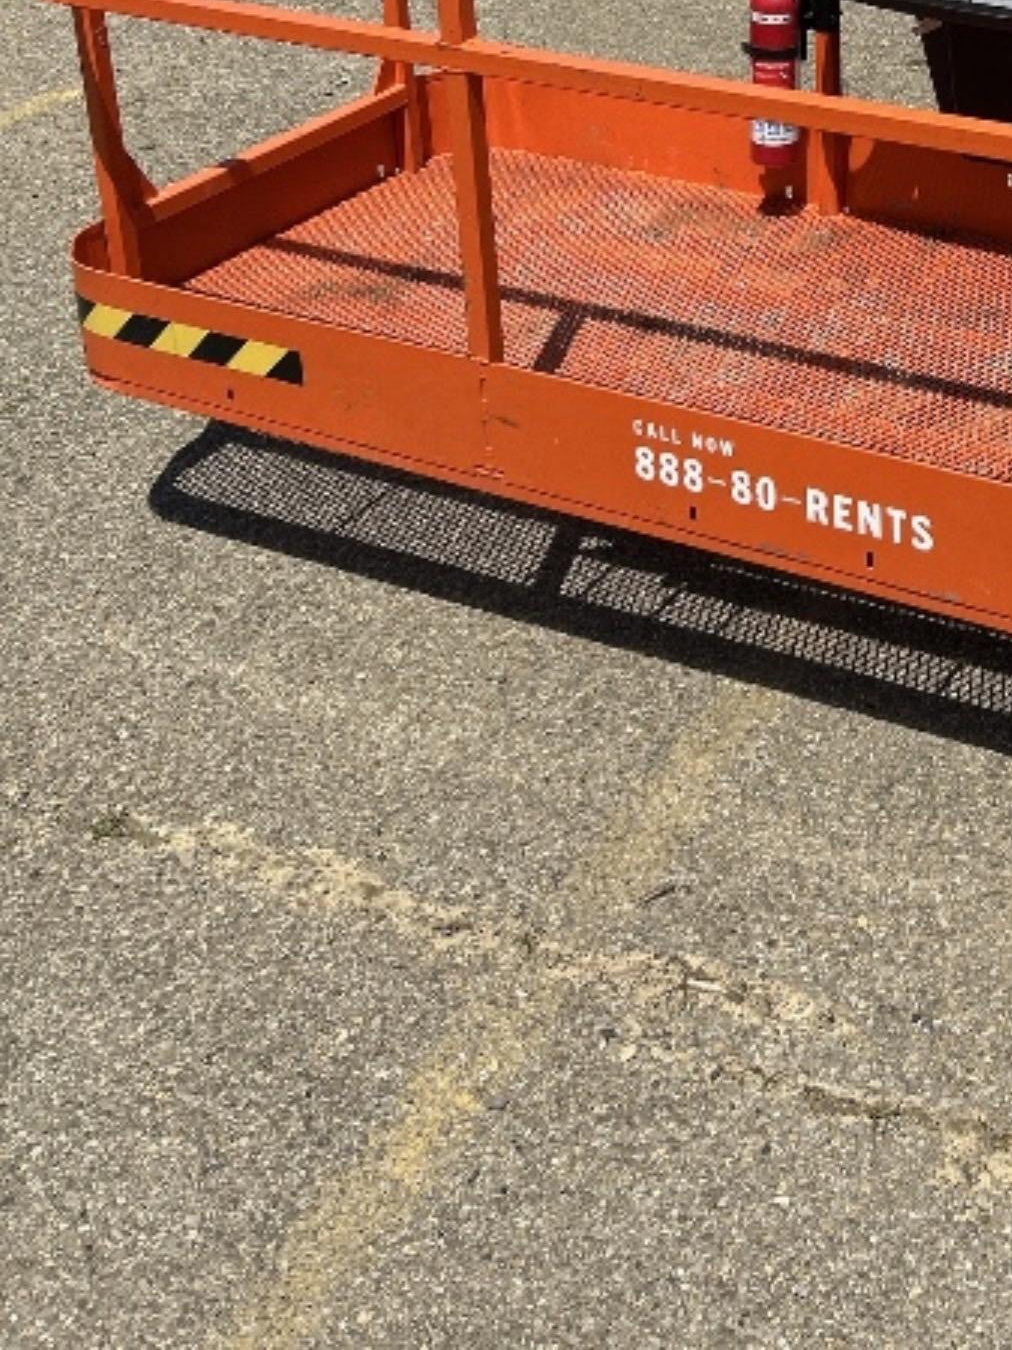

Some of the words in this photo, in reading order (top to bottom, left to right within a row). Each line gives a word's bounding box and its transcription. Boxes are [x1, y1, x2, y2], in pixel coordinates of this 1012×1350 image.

[632, 419, 682, 445] CALL
[691, 432, 735, 457] NOW
[634, 446, 935, 550] 888-80-RENTS
